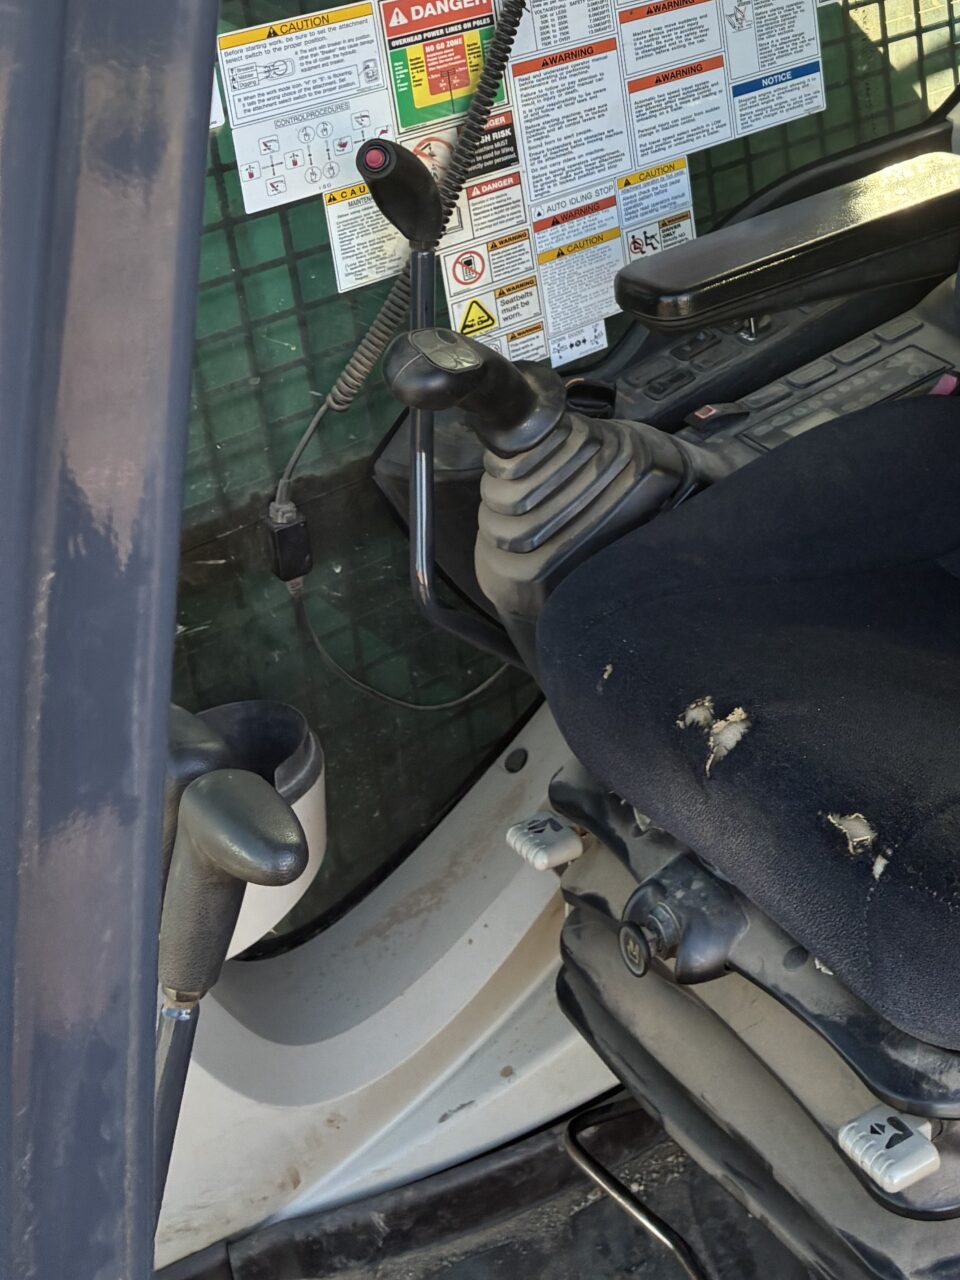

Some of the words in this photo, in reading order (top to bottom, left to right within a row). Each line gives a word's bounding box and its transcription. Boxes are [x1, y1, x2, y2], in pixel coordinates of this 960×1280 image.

[279, 15, 330, 35] CAUTION
[391, 34, 423, 48] OVERHEAD
[423, 29, 444, 39] POWER
[445, 24, 462, 34] LINES
[472, 17, 491, 27] POLES
[425, 44, 435, 53] NO
[436, 42, 445, 50] GO
[446, 38, 463, 48] ZONE
[549, 46, 594, 65] WARNING
[661, 64, 703, 82] WARNING
[761, 71, 792, 87] NOTICE
[492, 129, 512, 140] RISK
[494, 140, 508, 148] MUST
[638, 163, 675, 182] CAUTION
[481, 178, 514, 193] DANGER
[348, 196, 373, 209] MAINTEN
[546, 200, 567, 214] AUTO
[568, 191, 593, 207] IDLING
[594, 184, 614, 199] STOP
[561, 203, 600, 222] WARNING
[661, 224, 681, 234] DRIVER
[498, 232, 528, 246] WARNING
[566, 234, 604, 253] CAUTION
[505, 279, 535, 293] WARNING
[499, 291, 534, 307] Seatbelts
[501, 304, 519, 315] must
[502, 312, 522, 322] worn.
[515, 324, 543, 337] WARNING
